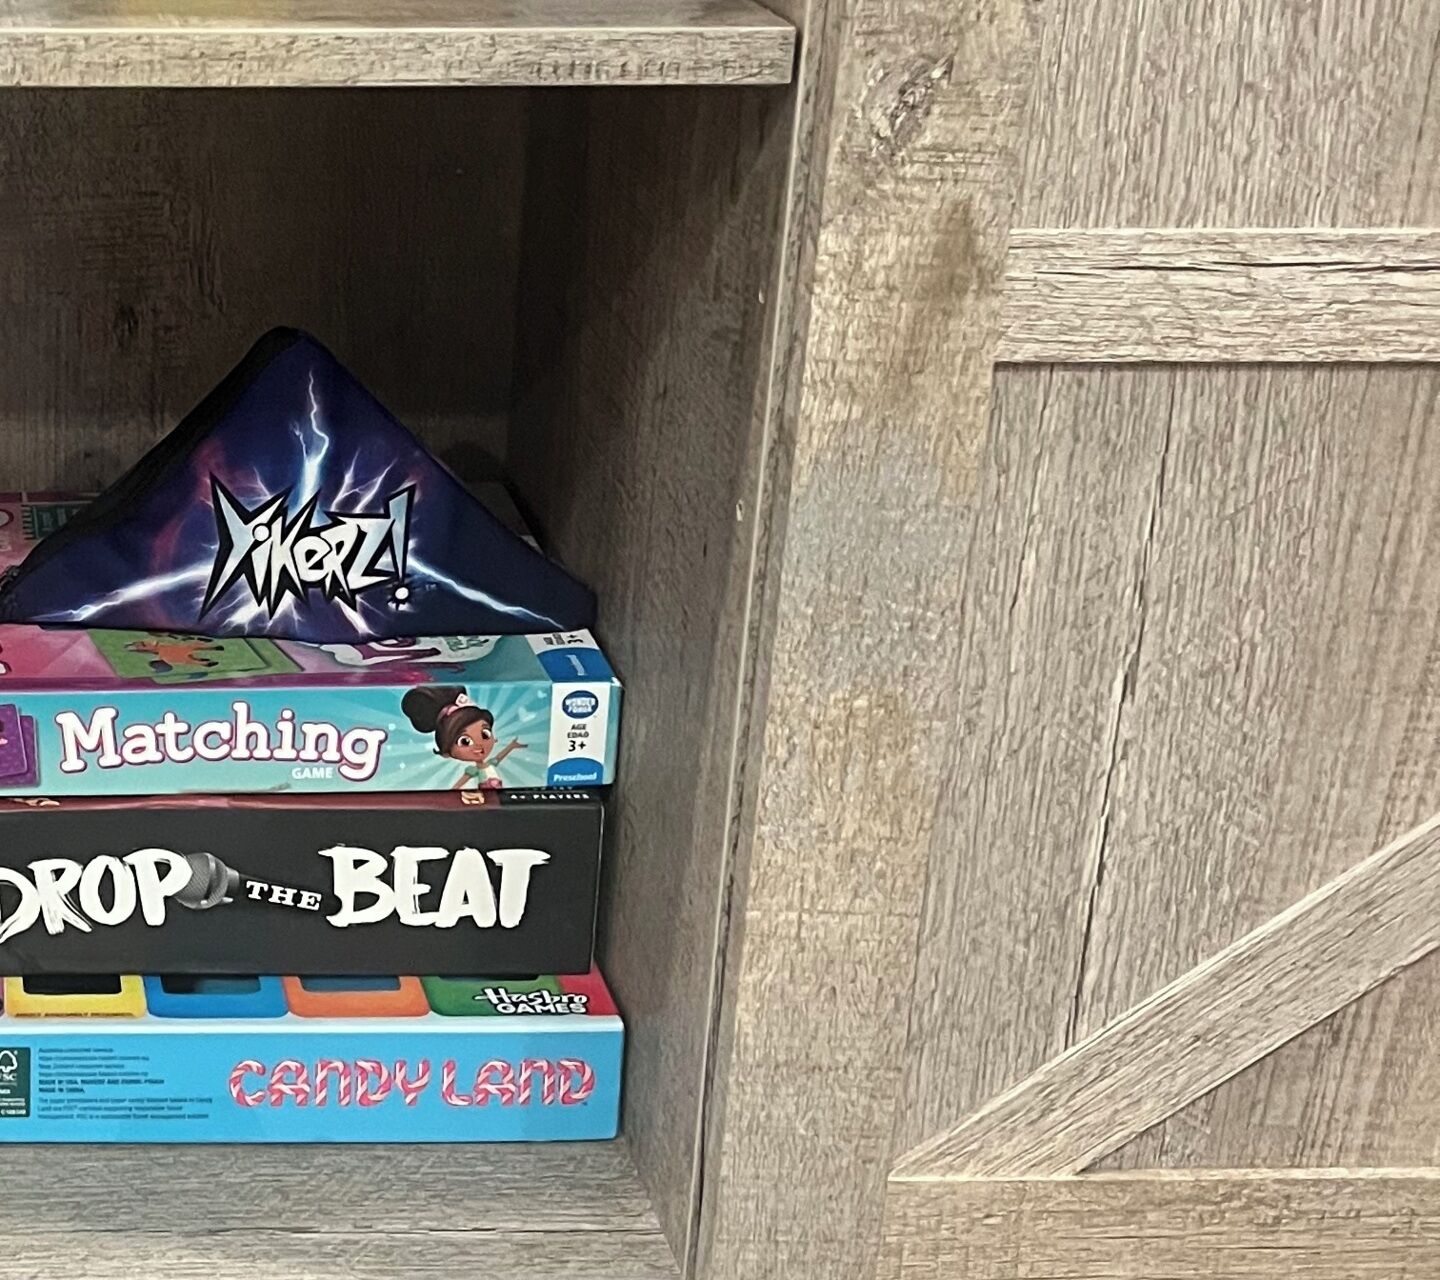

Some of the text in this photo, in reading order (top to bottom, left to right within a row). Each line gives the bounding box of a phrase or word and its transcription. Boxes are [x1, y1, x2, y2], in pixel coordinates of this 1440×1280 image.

[571, 723, 588, 731] AGE
[56, 700, 387, 781] Matching
[567, 731, 590, 739] EDAD
[568, 740, 587, 752] 3+
[292, 767, 333, 780] GAME
[245, 880, 323, 911] THE
[318, 843, 552, 928] BEAT
[474, 987, 590, 1007] Hasbro
[496, 1001, 589, 1015] GAMES
[228, 1058, 596, 1107] CANDY LAND
